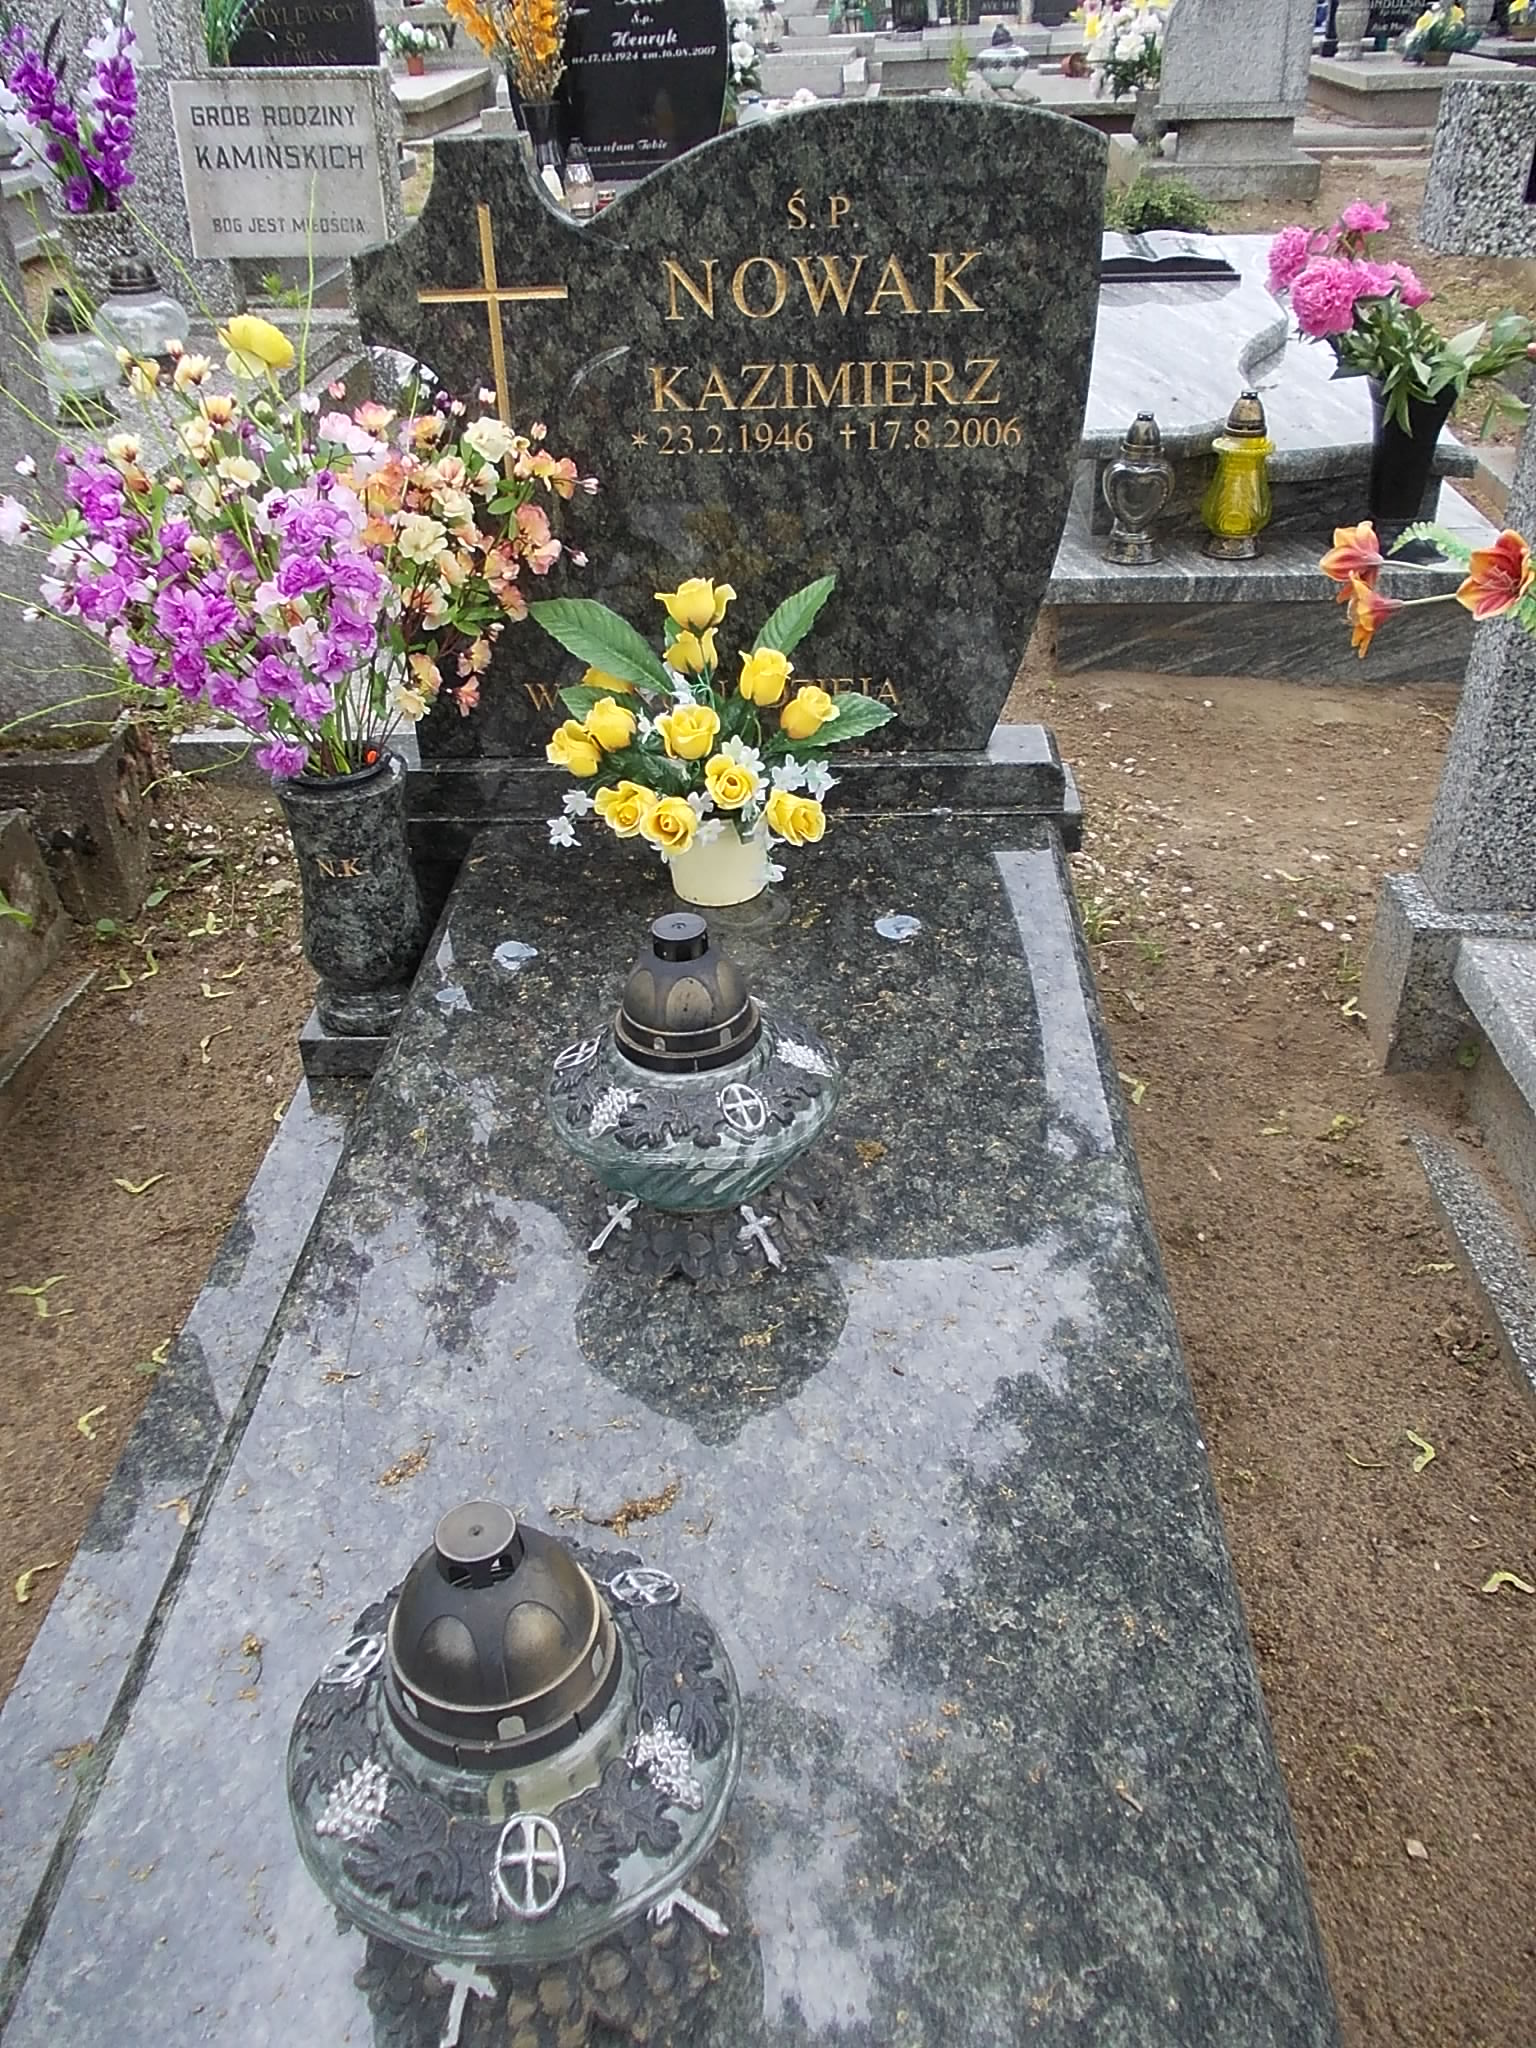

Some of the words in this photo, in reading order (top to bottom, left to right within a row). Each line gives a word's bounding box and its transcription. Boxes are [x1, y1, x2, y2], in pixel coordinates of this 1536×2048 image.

[611, 28, 678, 47] Henryk
[262, 105, 355, 127] RODZINY
[248, 217, 285, 233] JEST
[661, 251, 985, 321] NOWAK
[648, 358, 1002, 412] KAZIMIERZ
